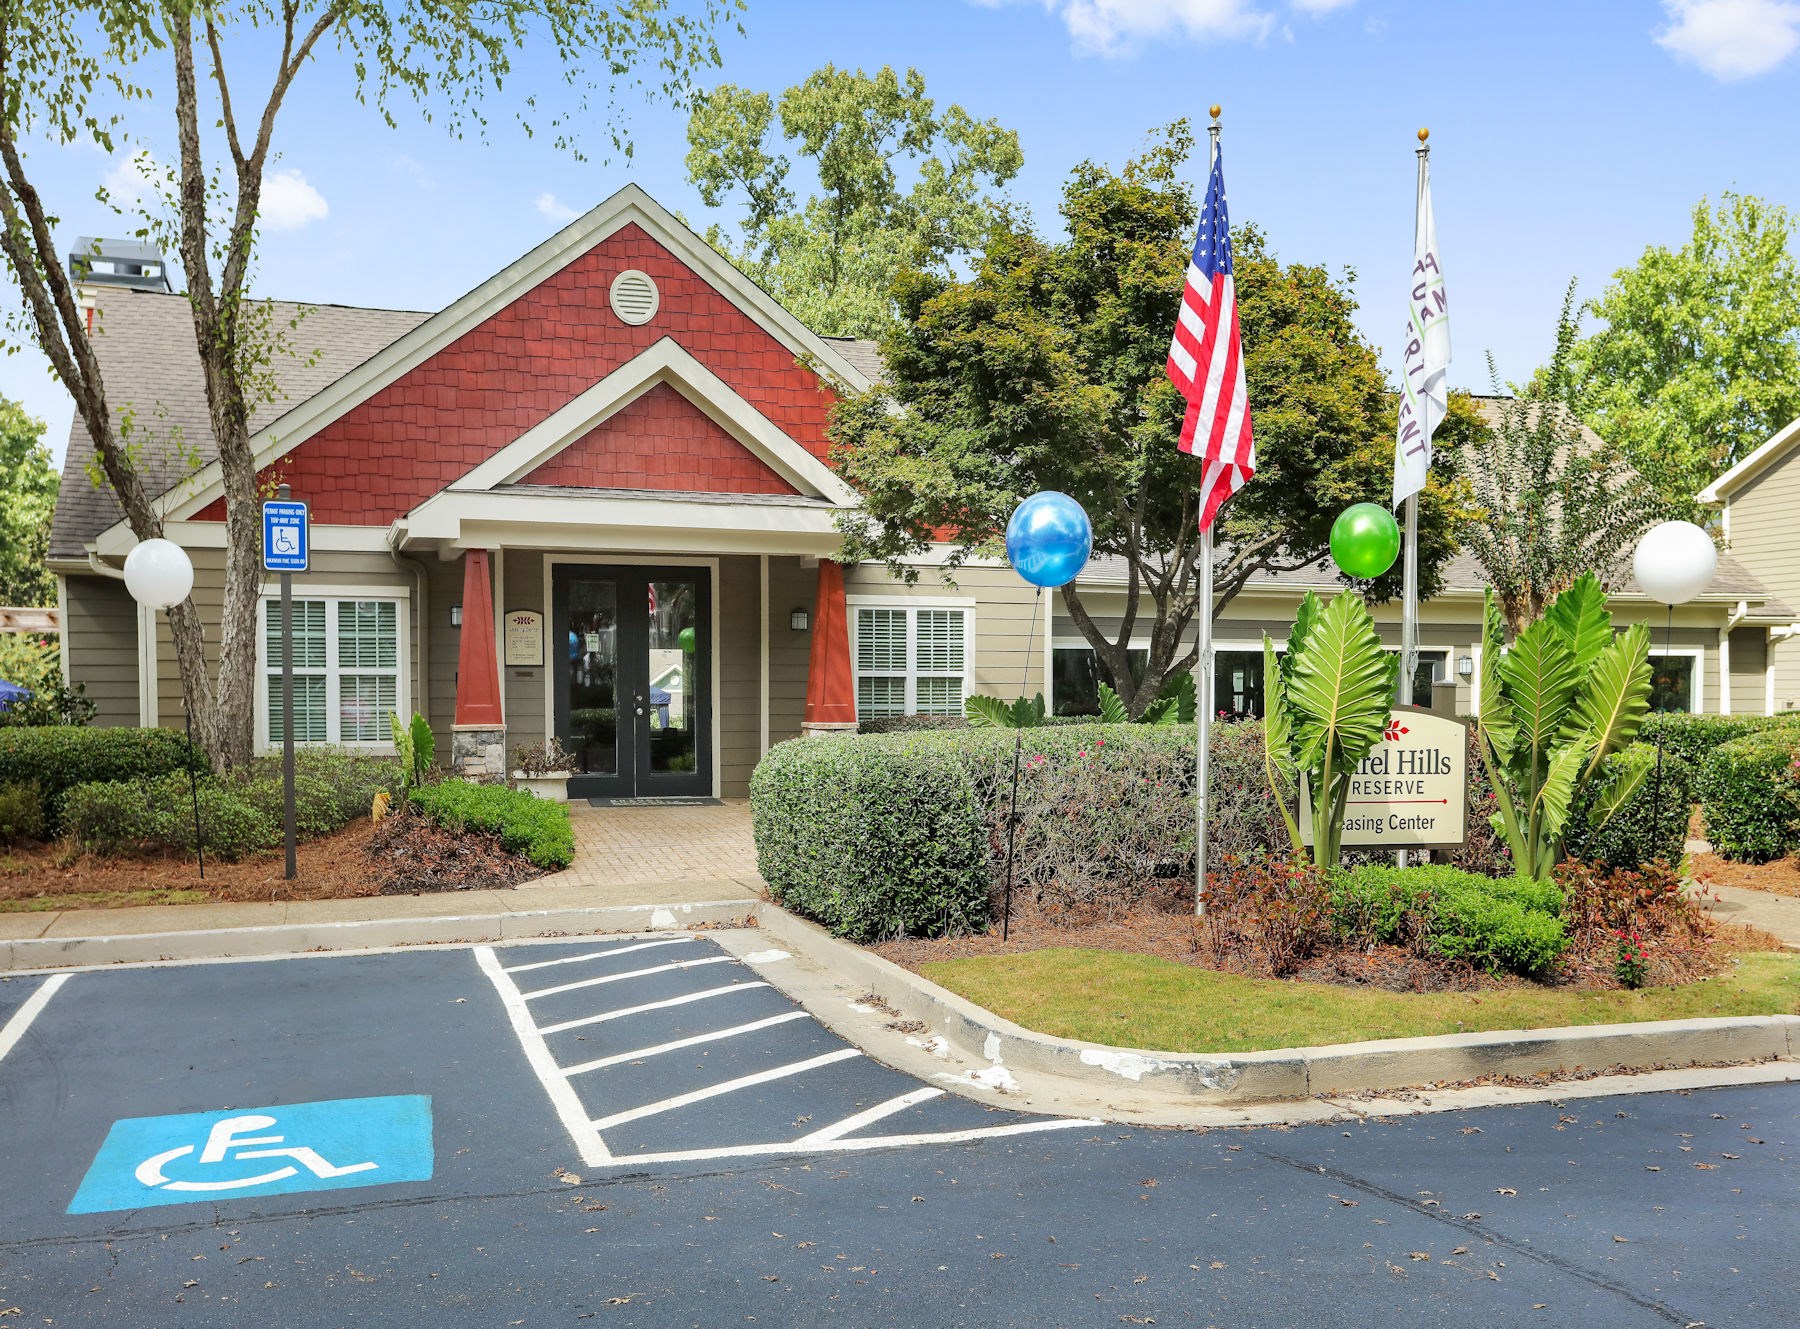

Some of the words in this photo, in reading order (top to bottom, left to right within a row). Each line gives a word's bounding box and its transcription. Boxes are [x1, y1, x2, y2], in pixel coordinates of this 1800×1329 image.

[1353, 749, 1390, 776] rel
[1397, 749, 1451, 775] Hills
[1352, 780, 1425, 795] RESERVE
[1341, 814, 1383, 834] asing
[1389, 814, 1435, 830] Center
